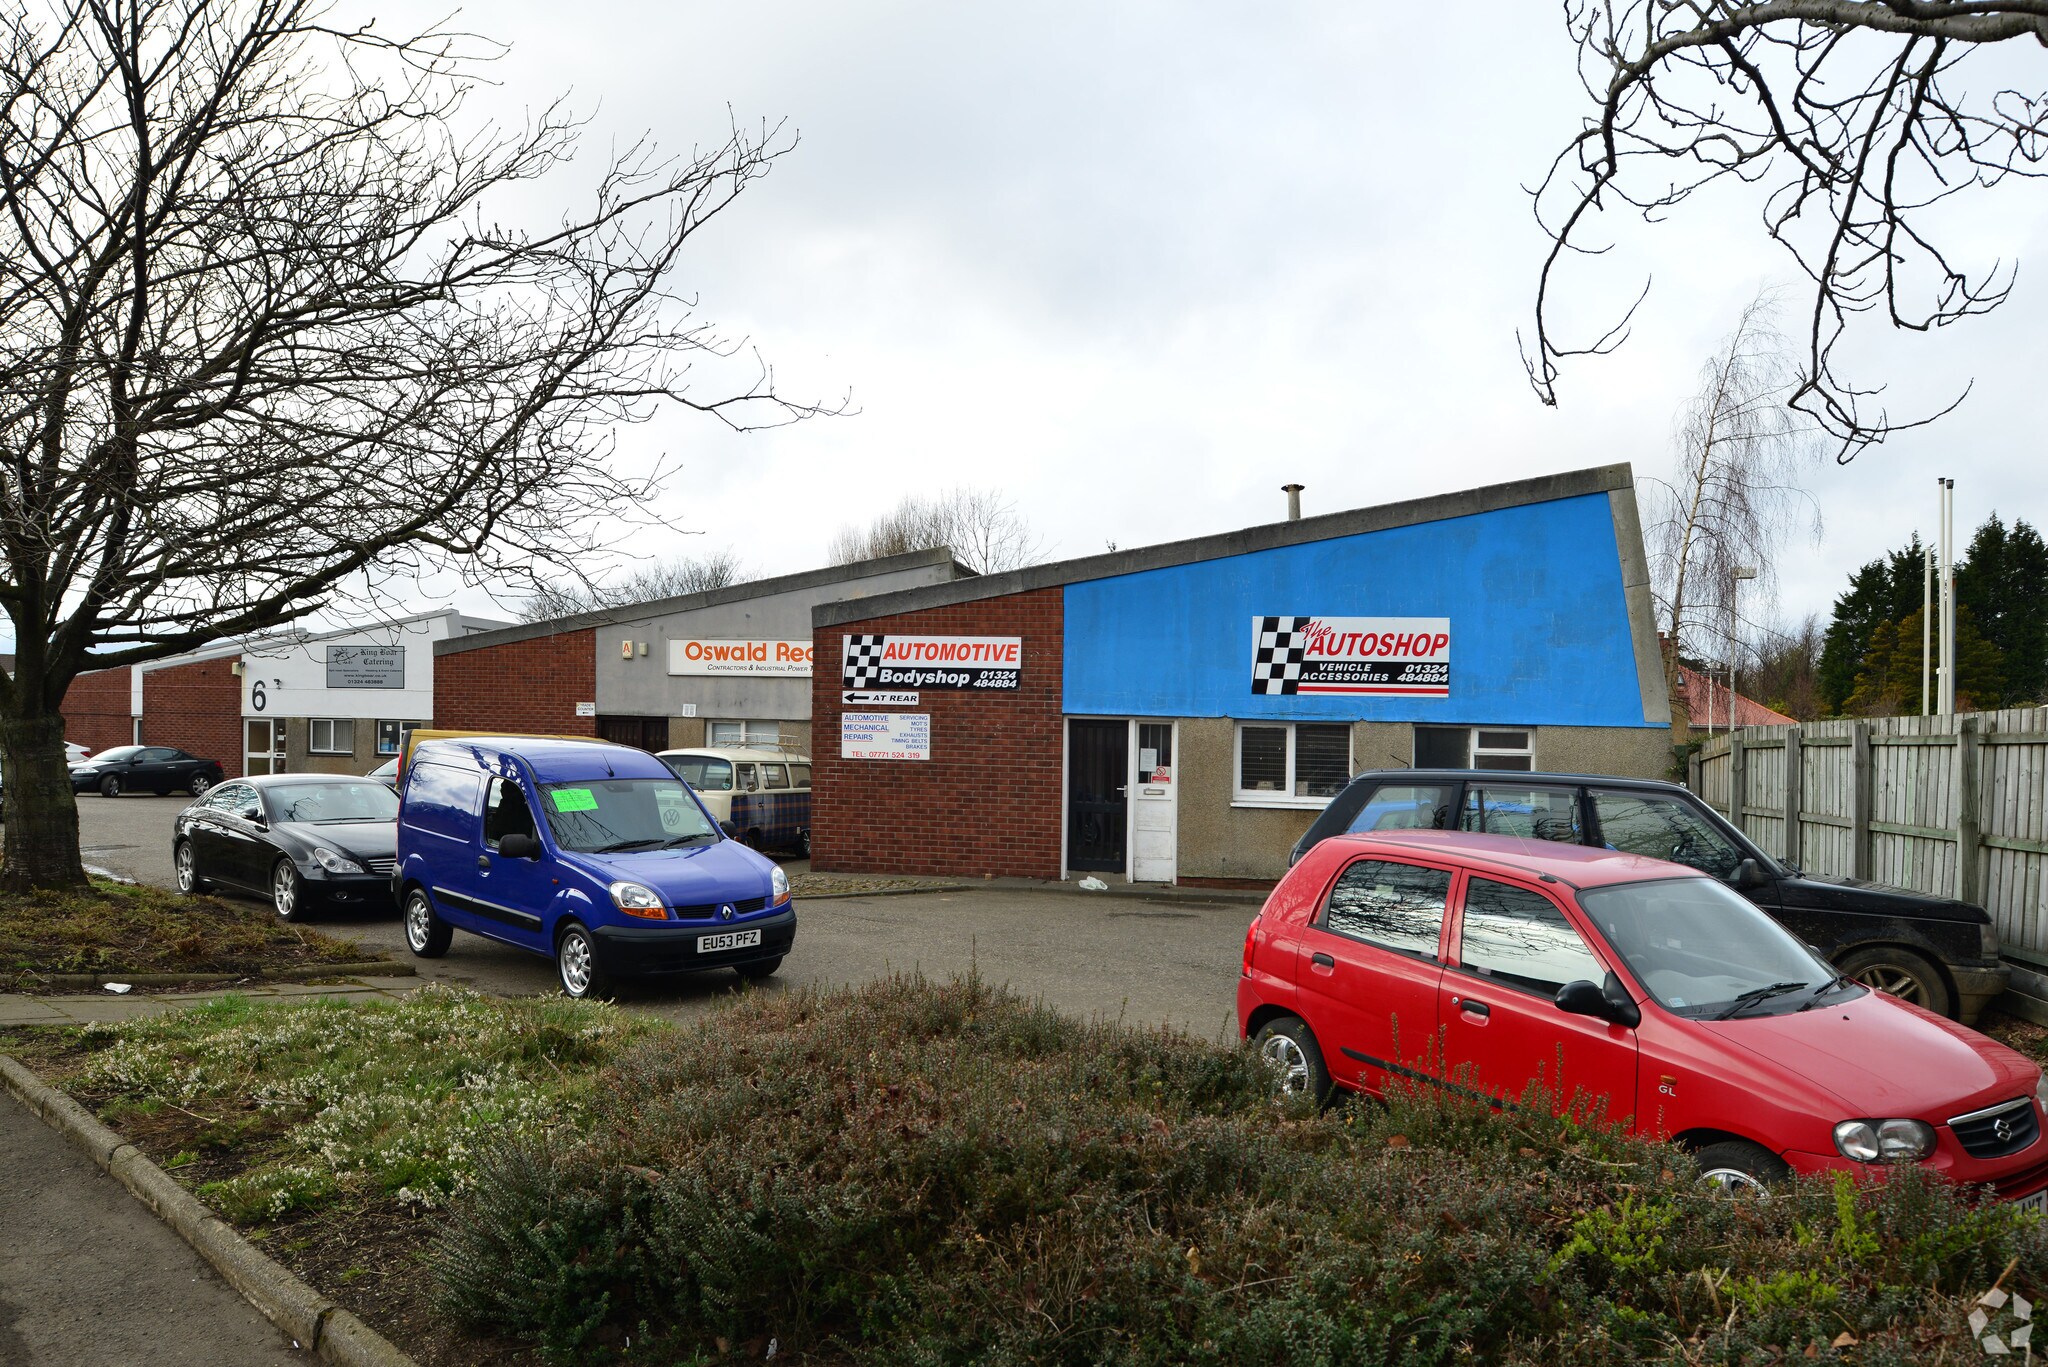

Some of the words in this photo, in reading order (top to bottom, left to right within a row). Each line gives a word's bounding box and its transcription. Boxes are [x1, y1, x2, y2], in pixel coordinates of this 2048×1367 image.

[1299, 620, 1332, 641] The
[1306, 632, 1449, 657] AUTOSHOP
[360, 648, 378, 657] King
[685, 641, 767, 661] Oswald
[882, 642, 1019, 662] AUTOMOTIVE
[363, 658, 394, 666] Catering
[1319, 663, 1372, 672] VEHICLE
[1405, 664, 1448, 673] 01324
[879, 669, 971, 686] Bodyshop
[979, 670, 1017, 679] 01324
[1300, 672, 1389, 681] ACCESSORIES
[1397, 673, 1448, 682] 484884
[972, 679, 1017, 688] 484884
[252, 680, 266, 712] 6
[872, 694, 887, 702] AT
[889, 694, 918, 702] REAR
[844, 714, 889, 722] AUTOMOTIVE
[843, 733, 873, 741] REPAIRS
[703, 935, 733, 950] EU53
[736, 932, 757, 946] PFZ
[1658, 1085, 1676, 1097] GL
